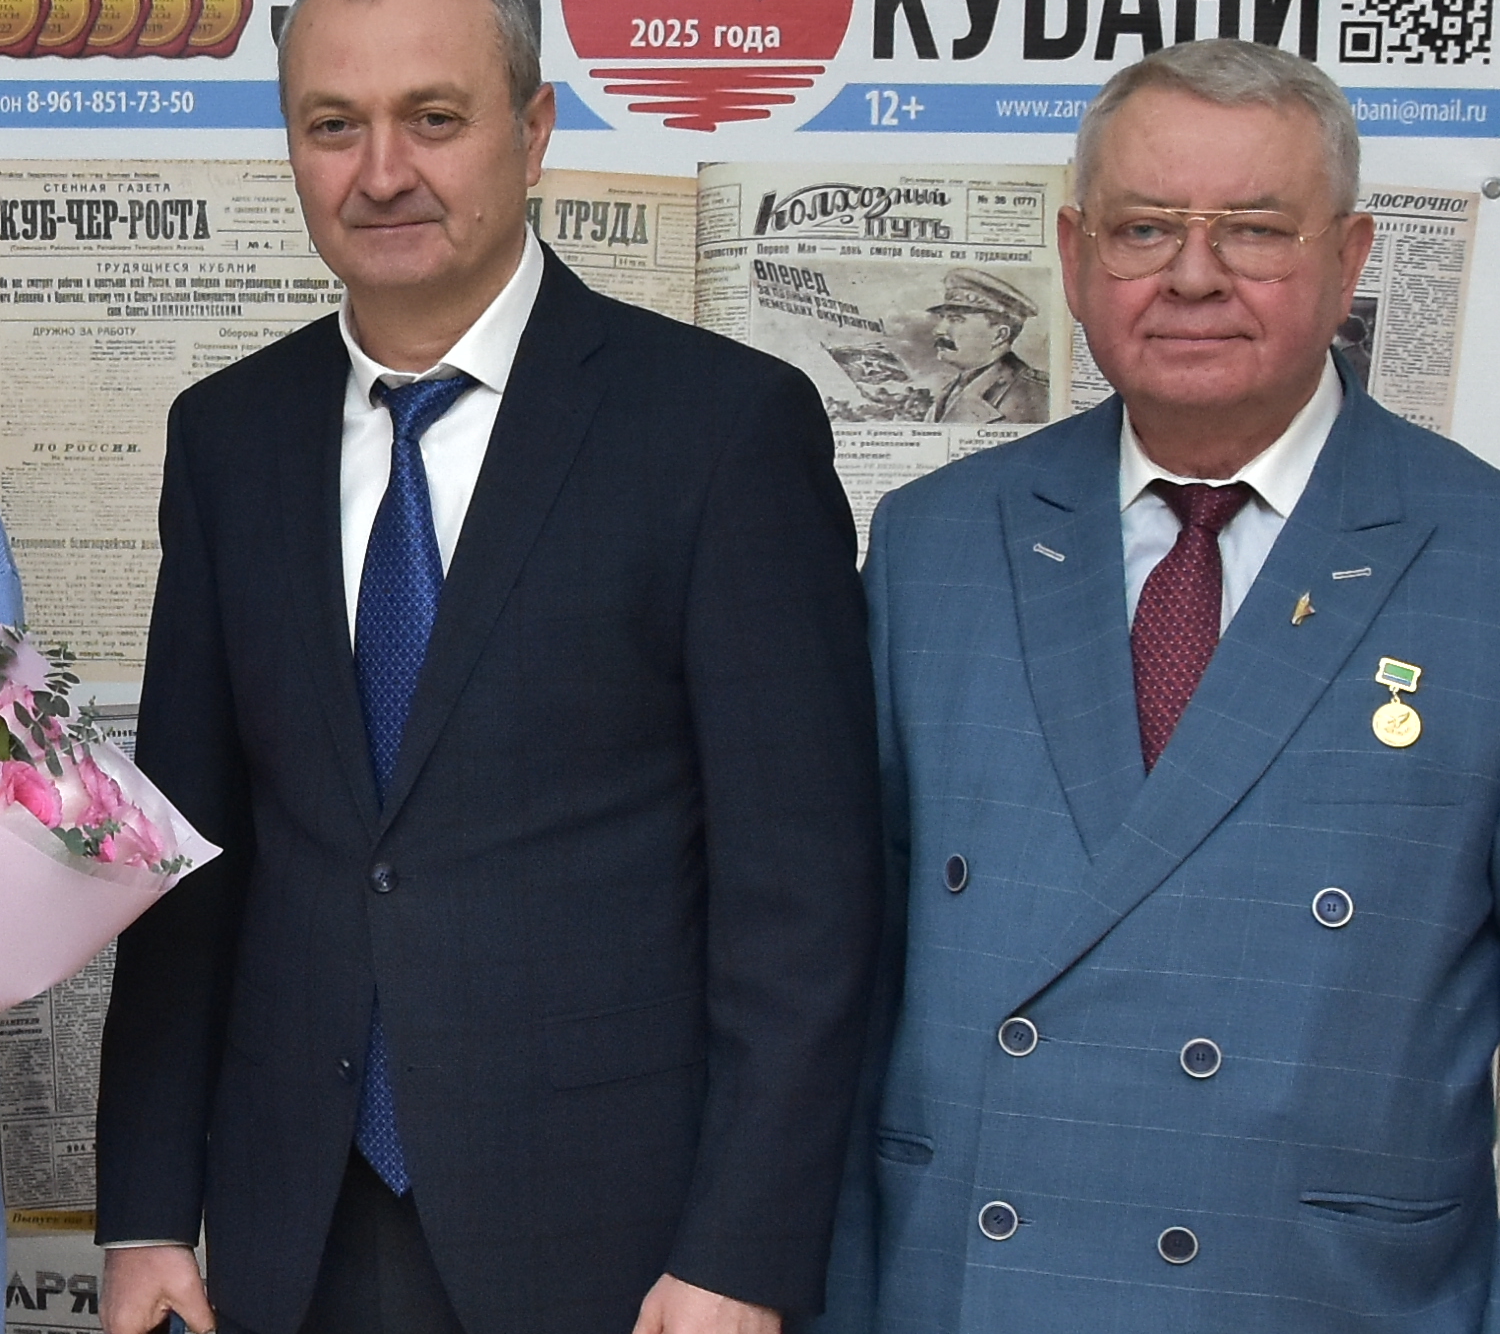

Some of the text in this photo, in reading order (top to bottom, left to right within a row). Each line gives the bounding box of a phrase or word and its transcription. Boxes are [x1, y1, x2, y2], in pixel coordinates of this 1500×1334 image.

[630, 18, 780, 53] 2025 года
[26, 90, 194, 113] 8-961-851-73-50
[865, 89, 925, 126] 12+
[43, 182, 170, 193] СТЕННАЯ ГАЗЕТА
[1367, 191, 1470, 214] ДОСРОЧНО!
[0, 198, 212, 242] КУБ-ЧЕР-РОСТА
[556, 197, 650, 248] ТРУДА
[96, 262, 256, 274] ТРУДЯЩИЕСЯ КУБАНИ
[32, 326, 76, 336] ДРУЖНО
[79, 326, 93, 336] ЗА
